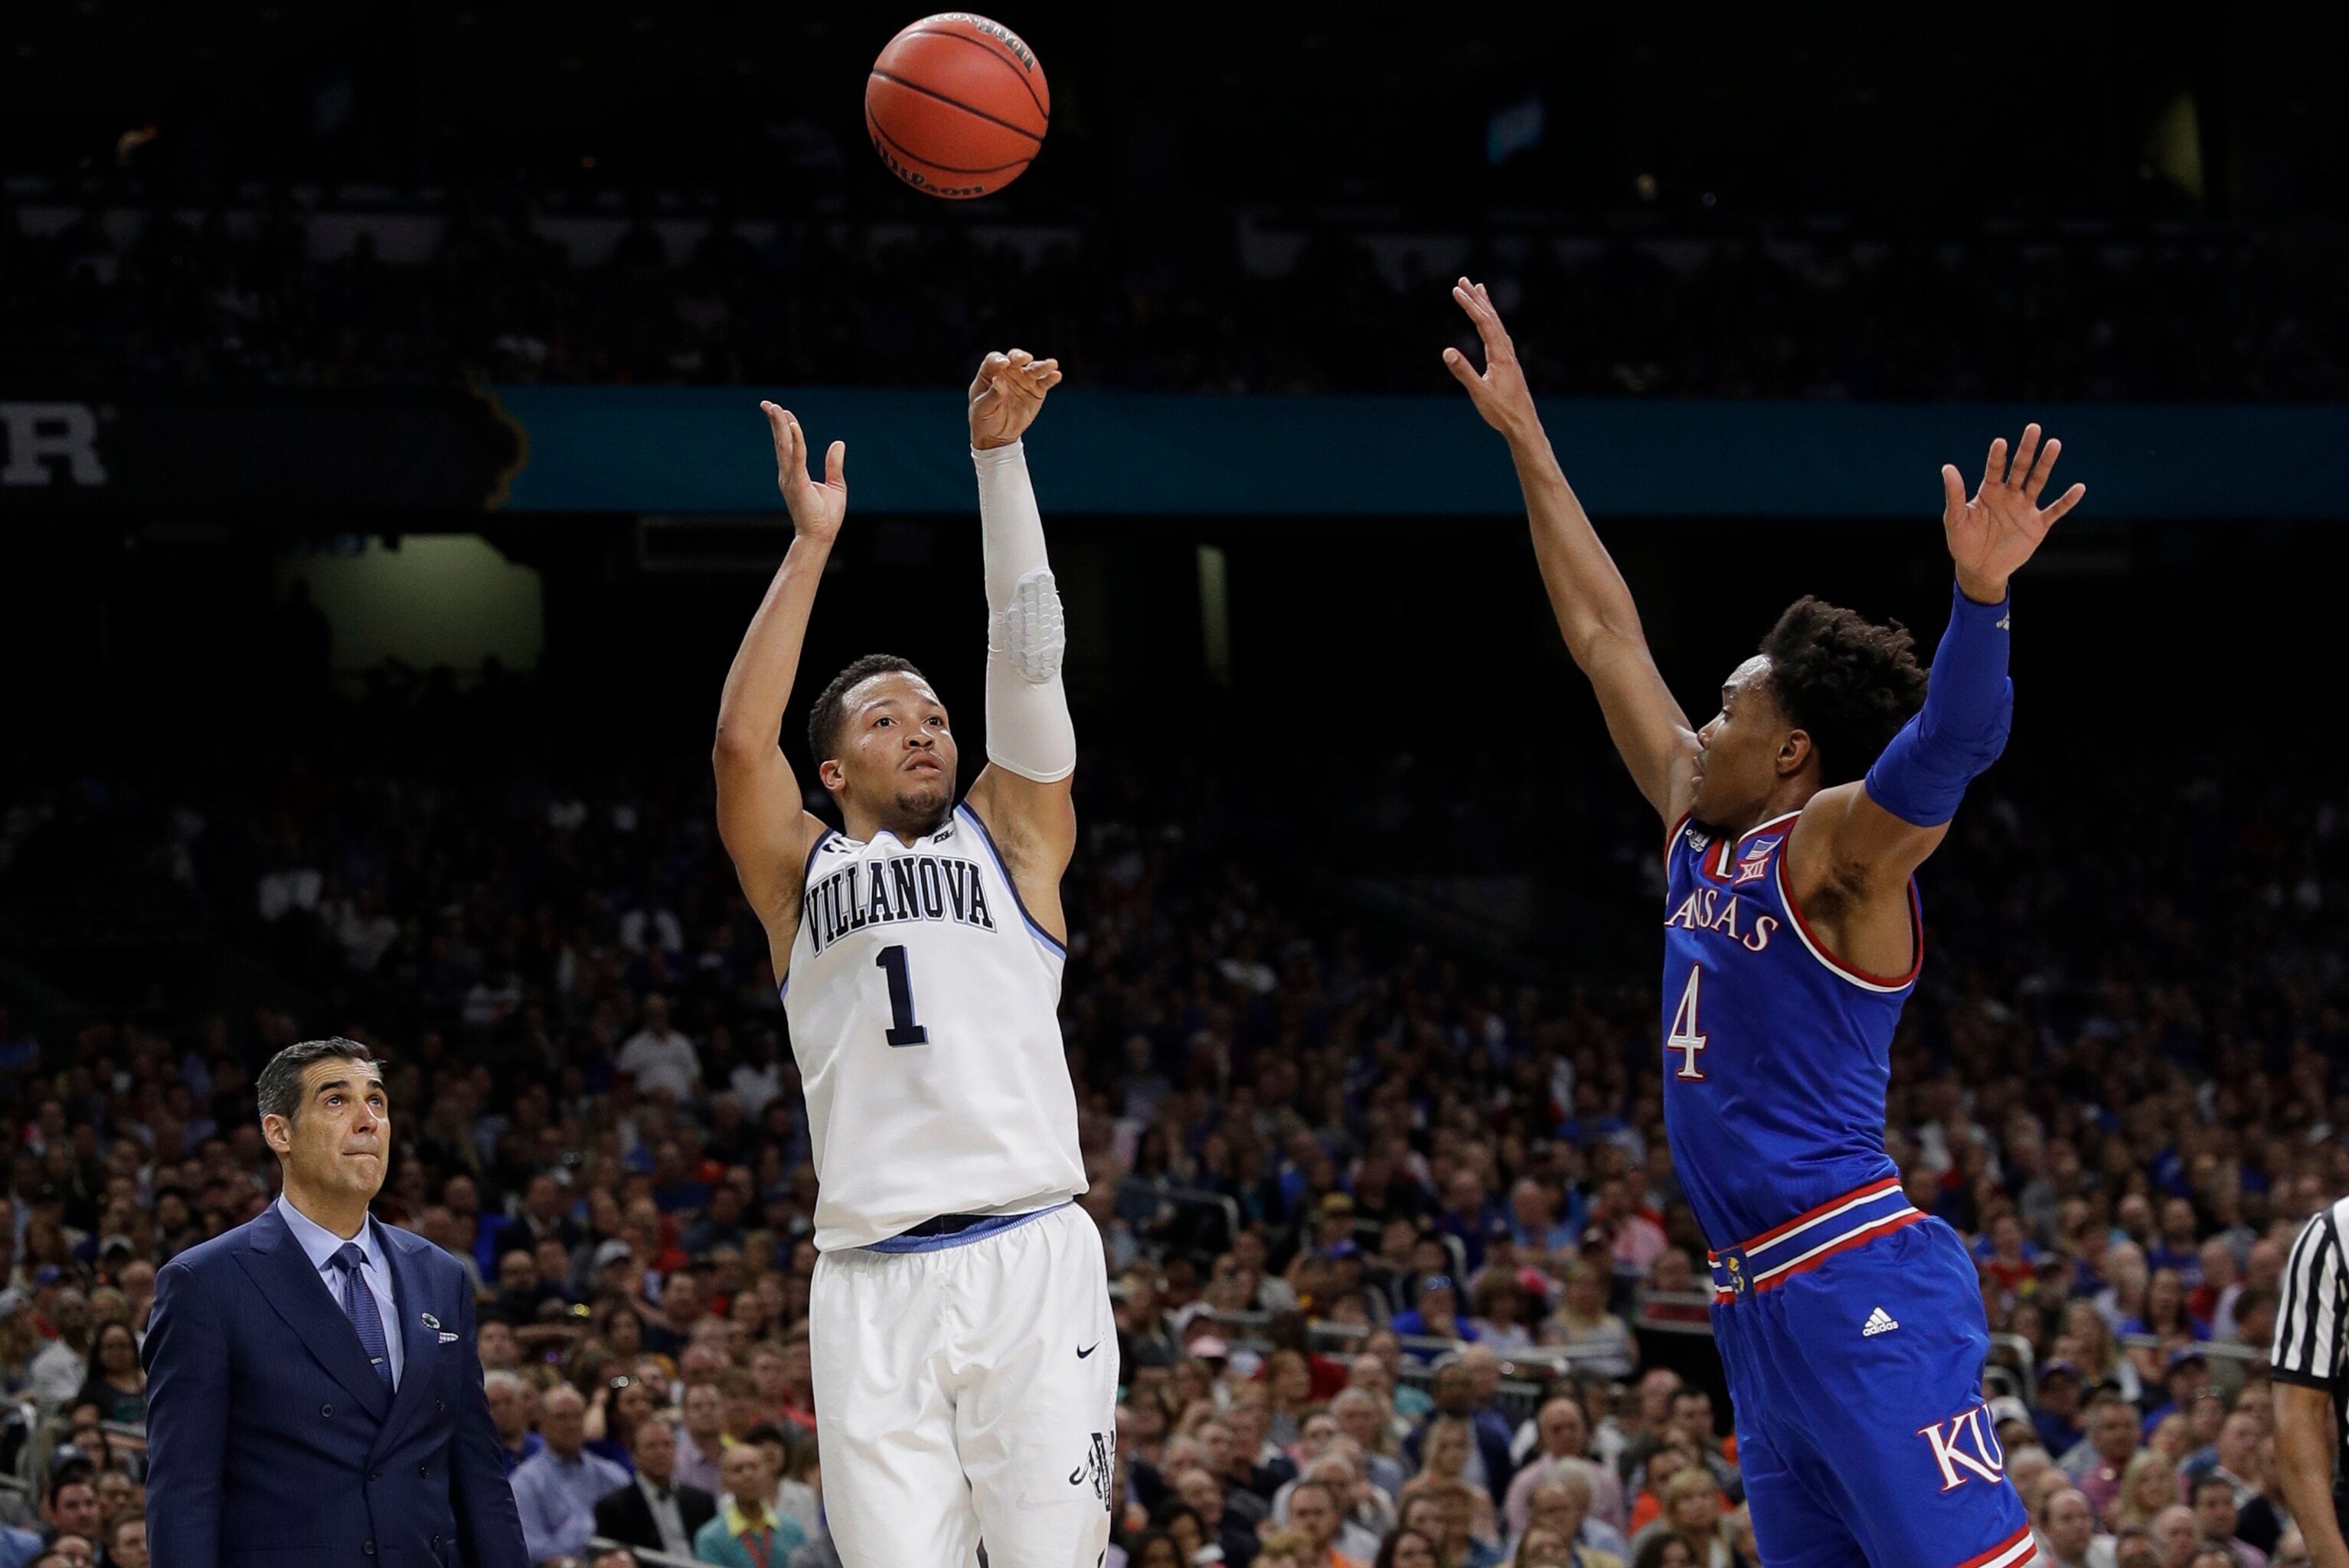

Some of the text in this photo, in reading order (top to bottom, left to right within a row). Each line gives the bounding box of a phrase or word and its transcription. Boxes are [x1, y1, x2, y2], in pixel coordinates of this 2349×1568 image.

[805, 854, 997, 959] VILLANOVA
[1733, 856, 1770, 887] XII
[1664, 887, 1779, 952] ANSAS
[876, 945, 929, 1047] 1
[1667, 962, 1707, 1080] 4
[1862, 1320, 1899, 1337] adidas
[1917, 1403, 2004, 1492] KU
